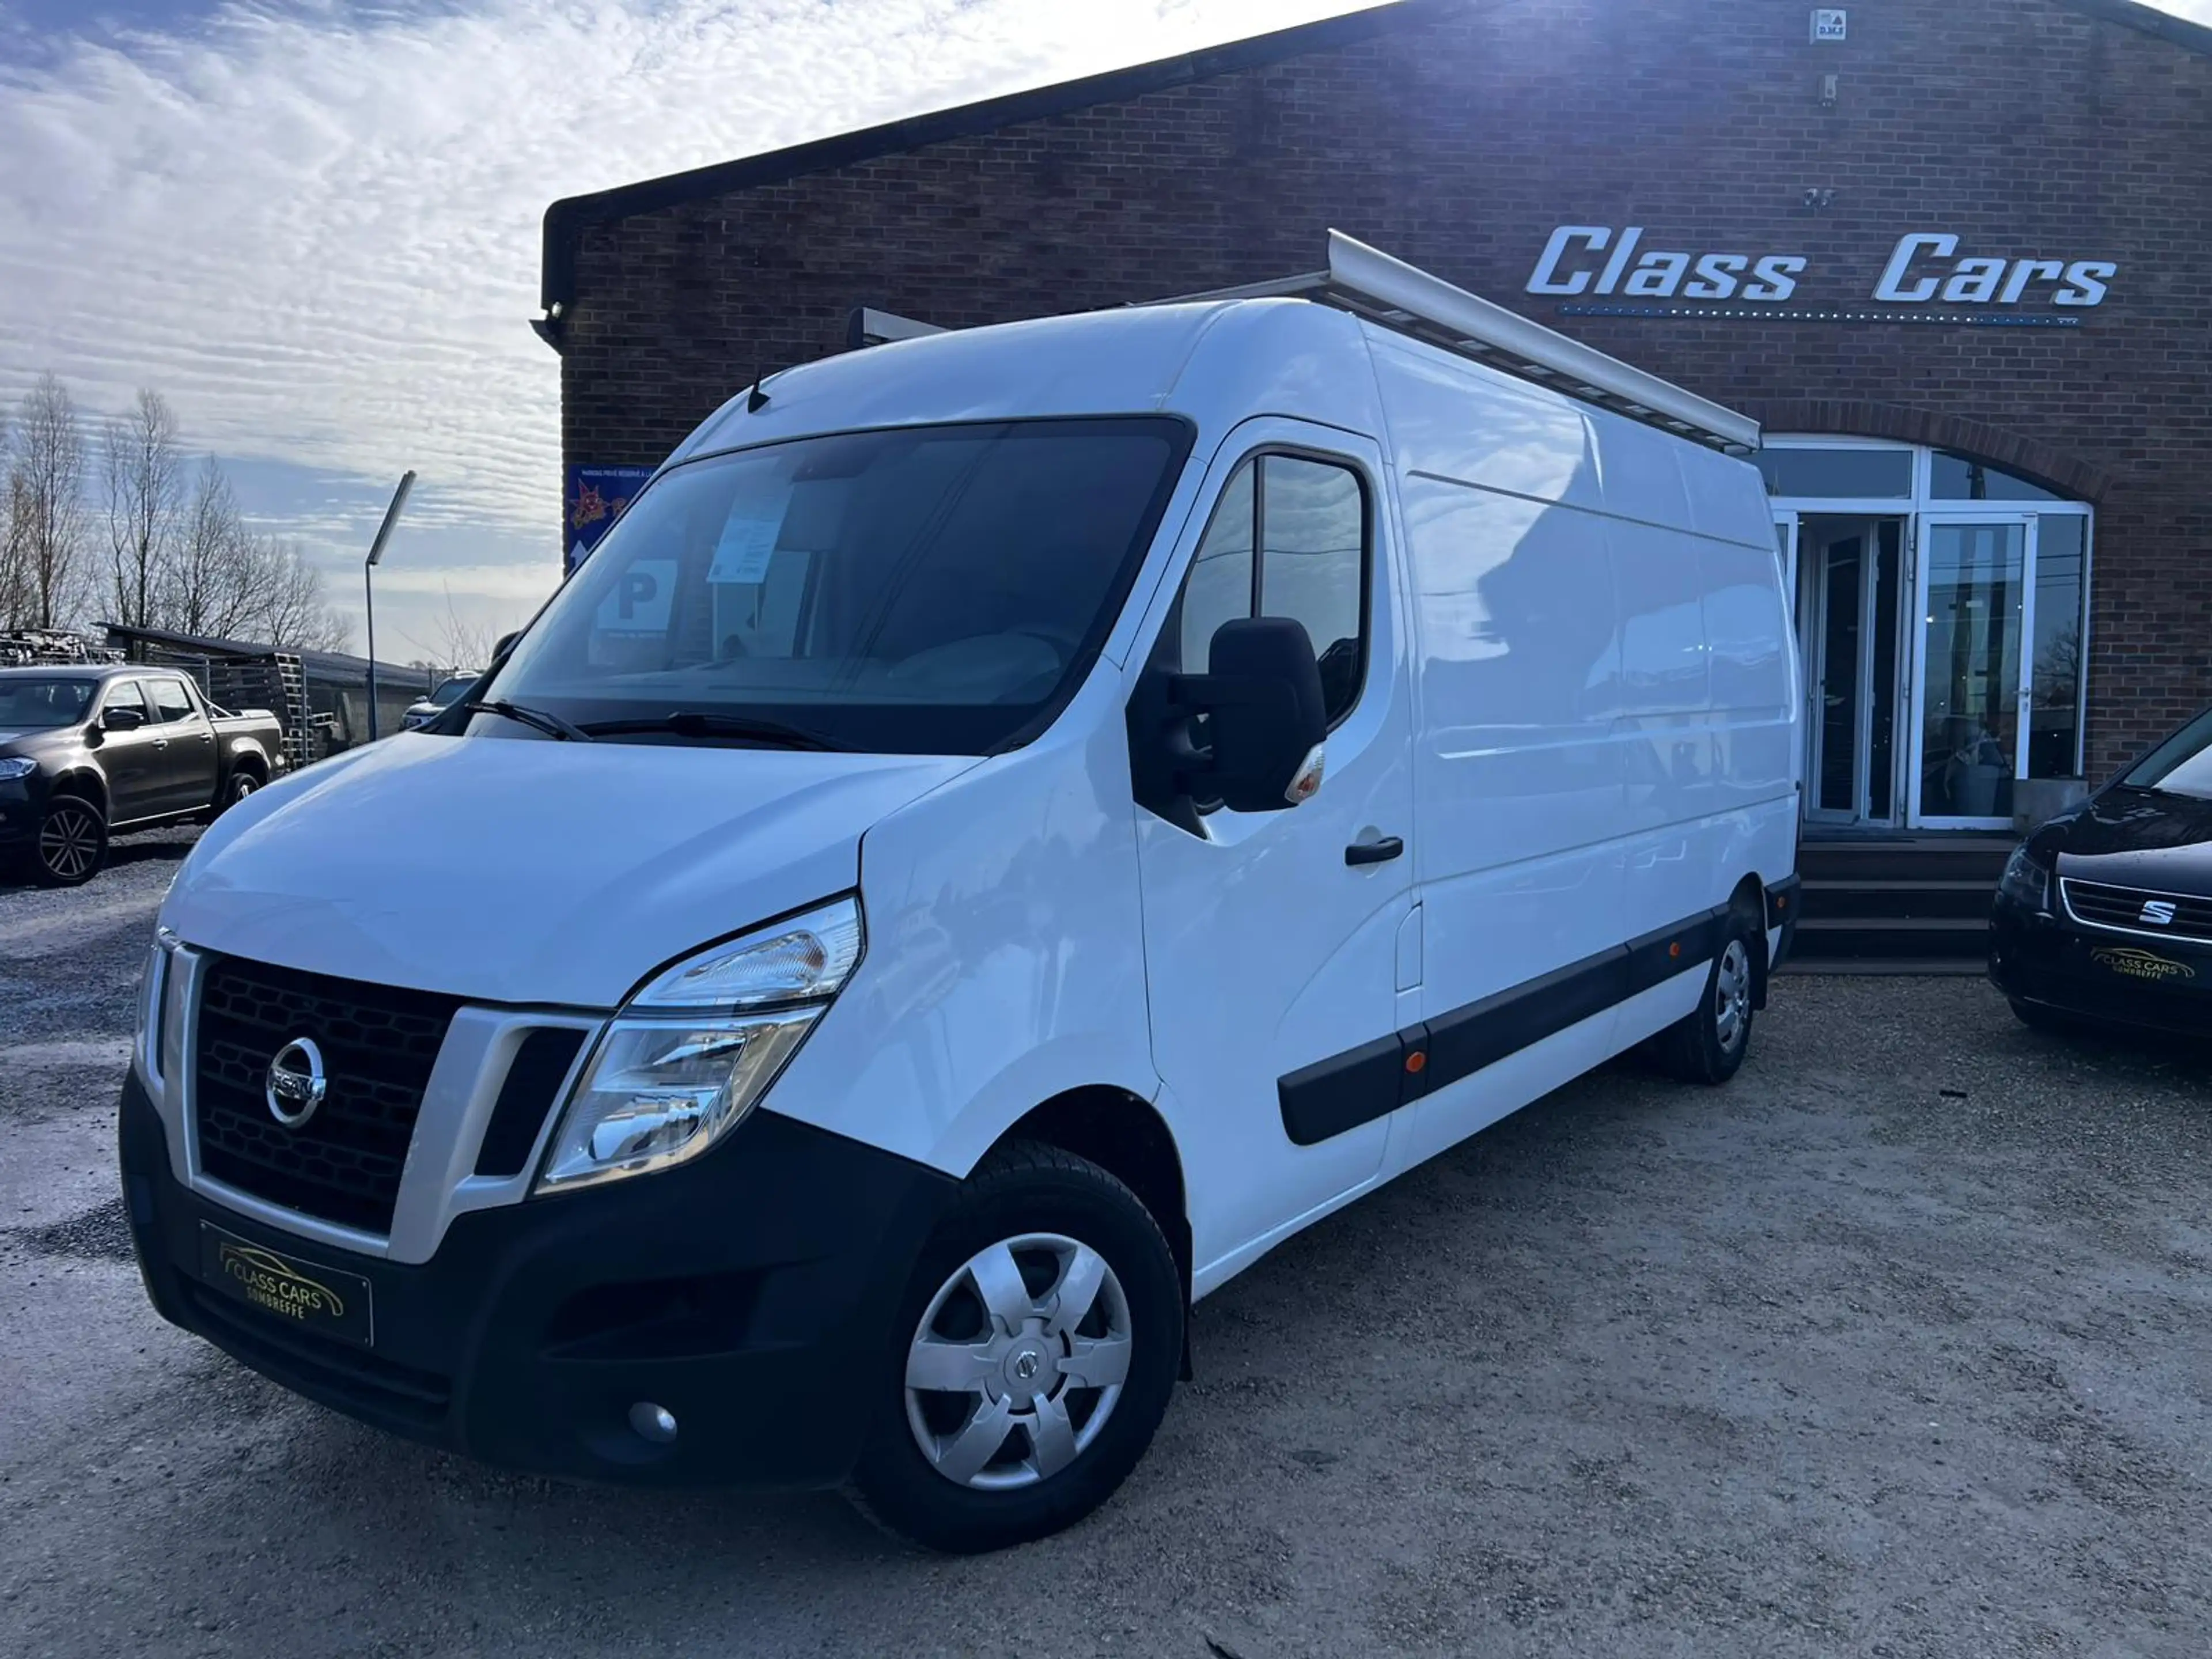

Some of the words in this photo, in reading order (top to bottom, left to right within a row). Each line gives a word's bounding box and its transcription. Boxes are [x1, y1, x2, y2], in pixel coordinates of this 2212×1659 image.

[1525, 225, 1808, 301] Class
[1872, 233, 2118, 306] Cars
[619, 573, 657, 619] P
[2104, 955, 2141, 969] CLASS
[2144, 961, 2178, 975] CARS
[272, 1070, 312, 1096] SAN
[233, 1263, 276, 1294] CLASS
[279, 1281, 322, 1309] CARS
[247, 1286, 305, 1319] SOMBREFFE
